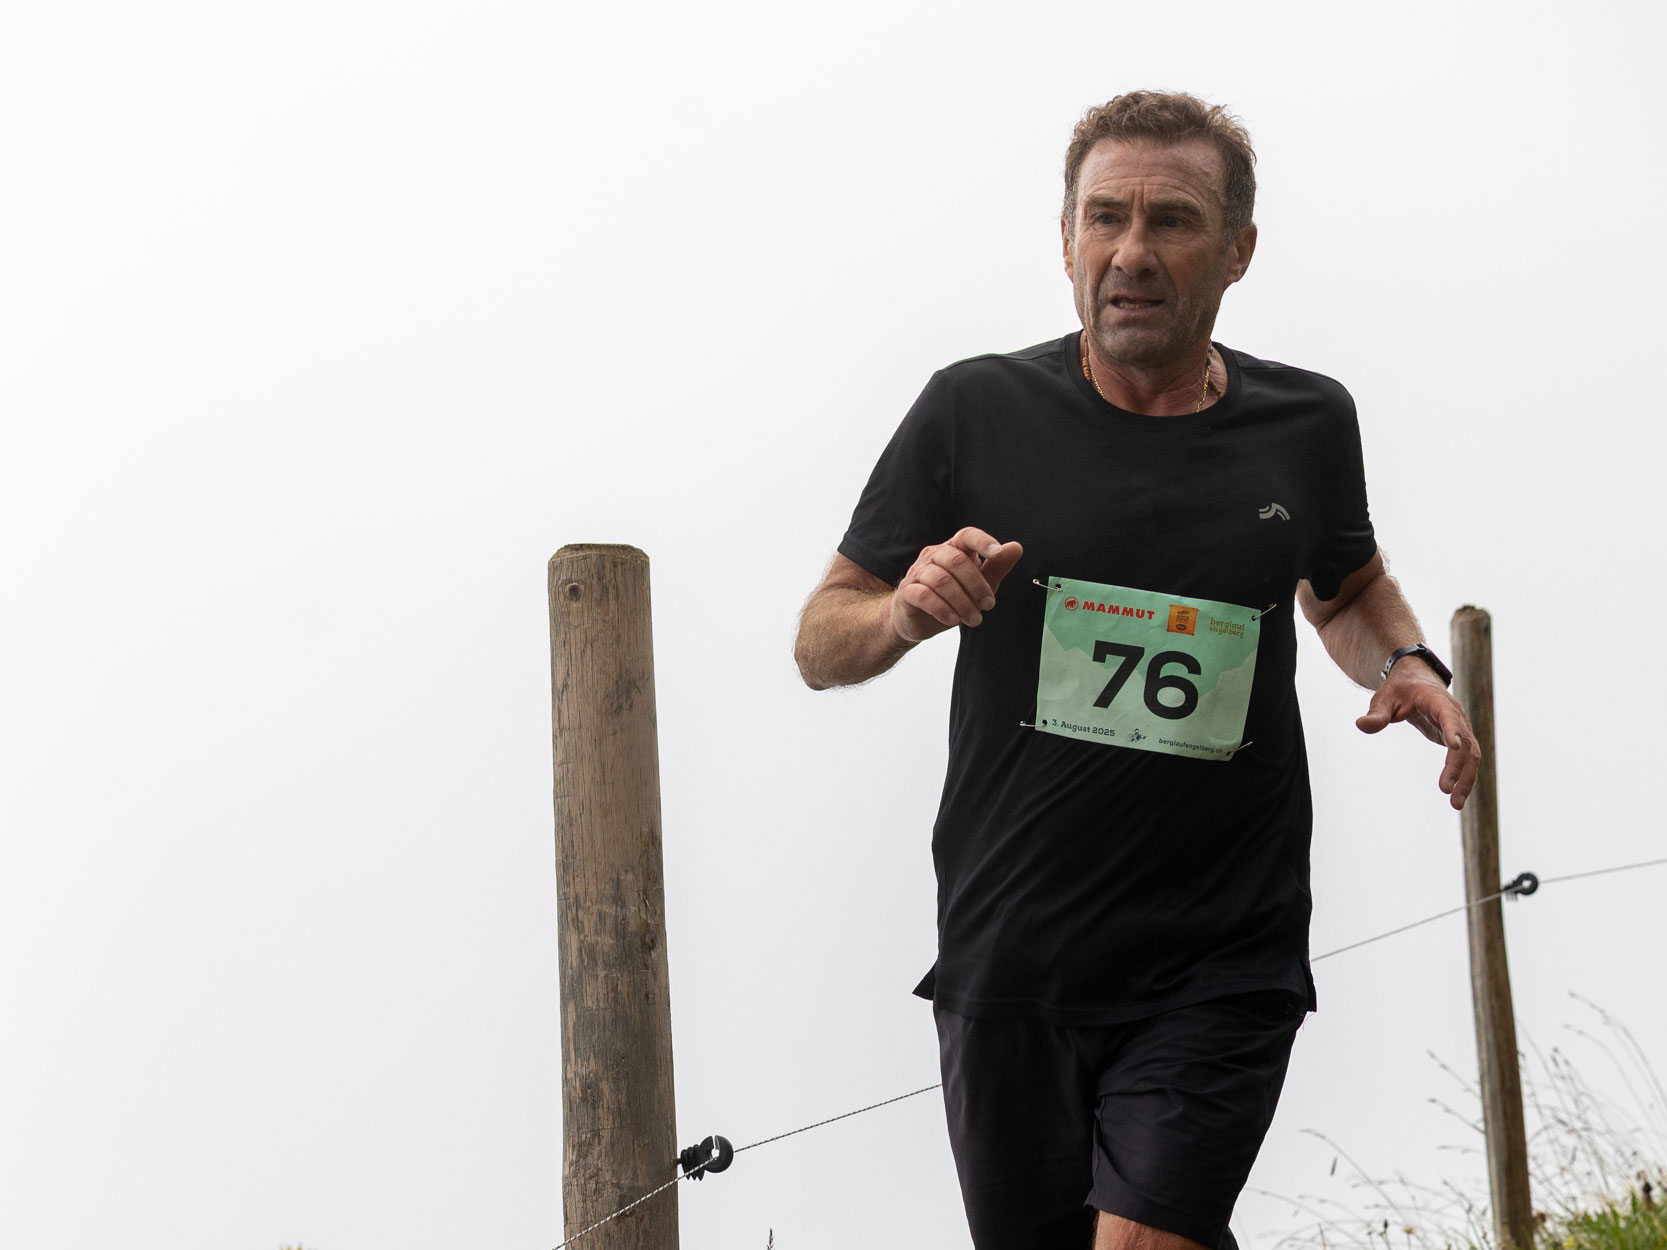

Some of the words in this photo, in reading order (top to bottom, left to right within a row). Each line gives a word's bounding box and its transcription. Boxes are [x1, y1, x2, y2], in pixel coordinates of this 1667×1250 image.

[1082, 601, 1155, 620] MAMMUT
[1210, 617, 1246, 630] berglauf
[1209, 626, 1244, 639] engelberg
[1092, 639, 1202, 720] 76
[1052, 718, 1060, 727] 3.
[1060, 720, 1091, 733] August
[1092, 726, 1116, 737] 2025
[1158, 738, 1223, 754] berglaufengelberg.ch
